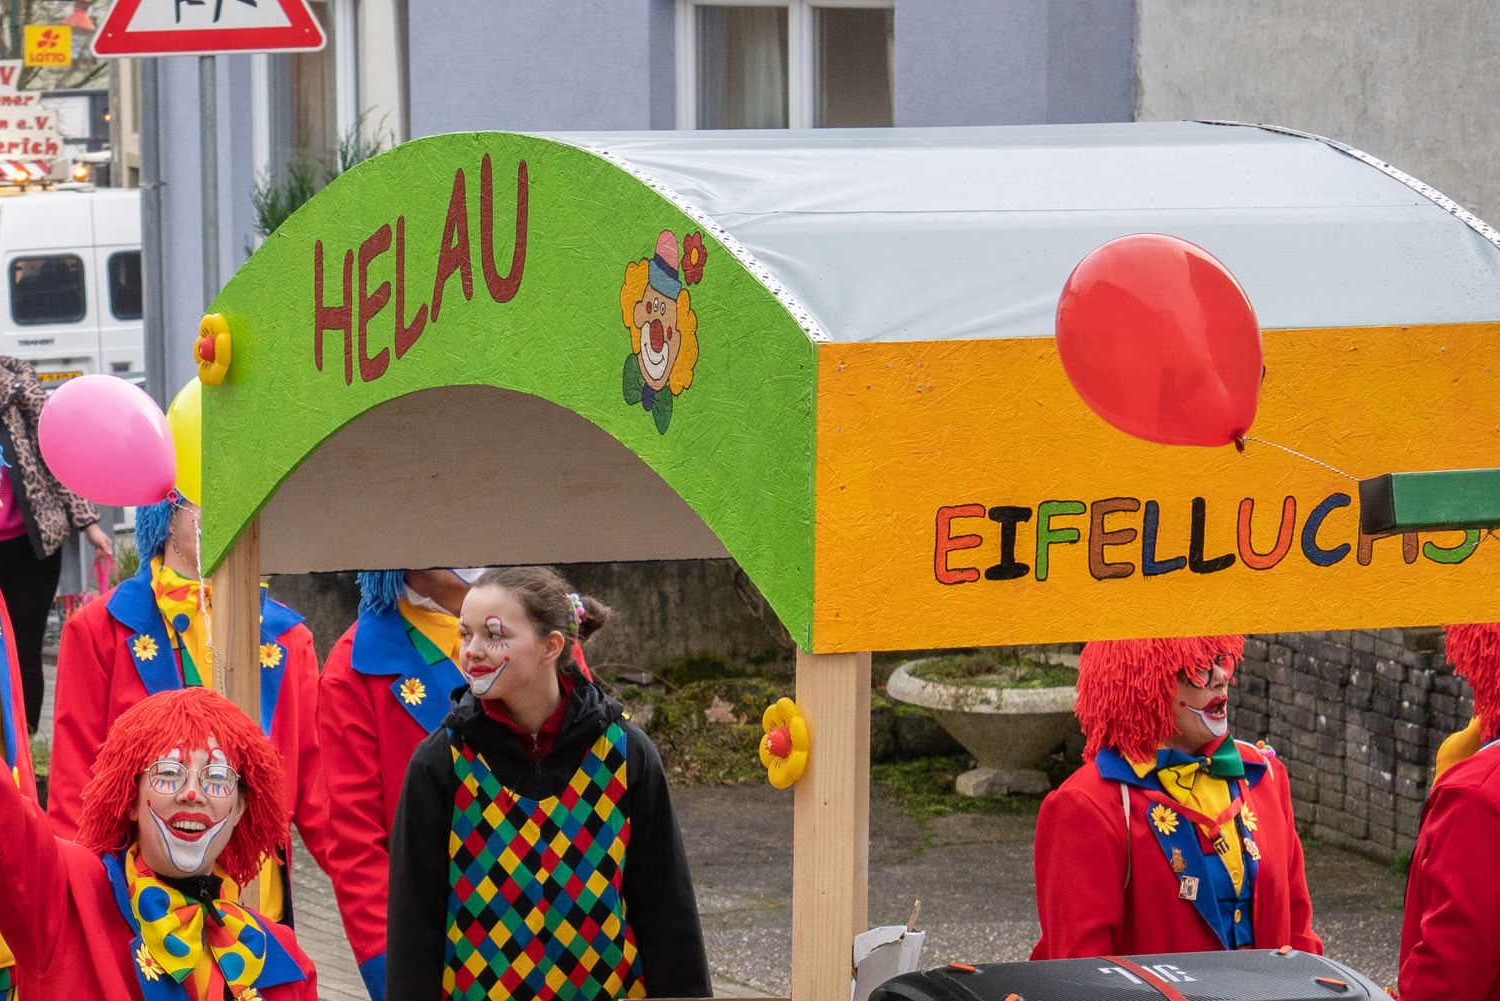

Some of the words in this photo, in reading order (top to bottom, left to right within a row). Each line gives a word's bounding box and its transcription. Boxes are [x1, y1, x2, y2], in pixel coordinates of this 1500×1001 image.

[30, 52, 66, 62] LOTTO
[16, 116, 53, 130] e.V.
[314, 152, 529, 385] HELAU
